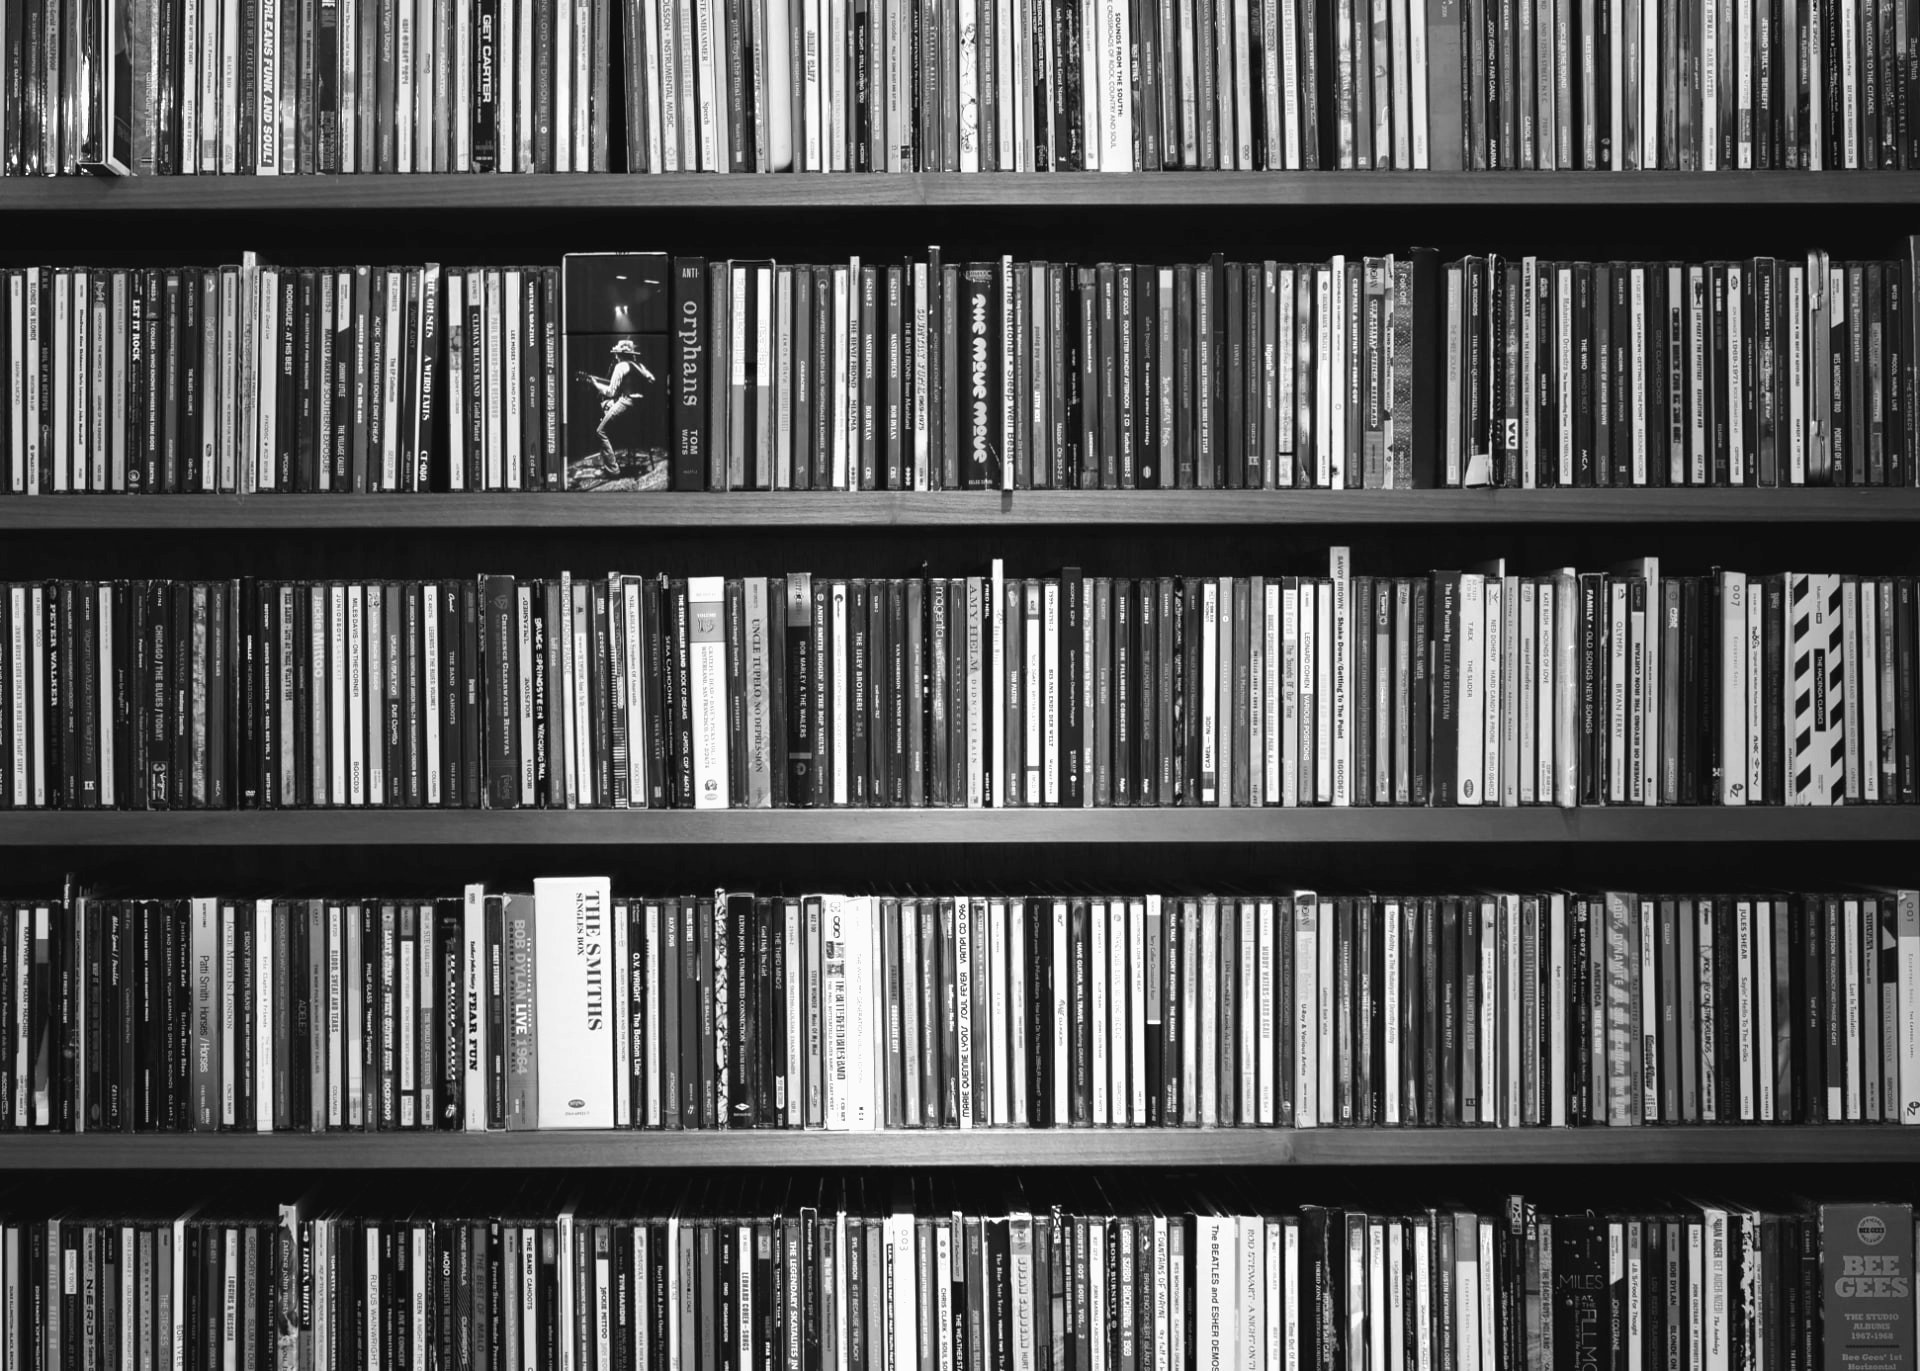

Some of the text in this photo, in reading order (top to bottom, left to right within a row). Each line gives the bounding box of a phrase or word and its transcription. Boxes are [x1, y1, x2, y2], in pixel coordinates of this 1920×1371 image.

[731, 19, 740, 38] pink
[483, 14, 492, 102] GET CARTER
[732, 39, 740, 60] floyd
[1108, 49, 1114, 59] OF
[264, 58, 273, 93] FUNK
[264, 95, 272, 123] AND
[666, 101, 674, 128] MUSIC
[702, 102, 710, 125] Speech
[263, 125, 272, 163] SOUL!
[132, 320, 140, 331] IT
[286, 332, 292, 342] AT
[1006, 307, 1014, 356] National
[132, 333, 140, 361] ROCK
[678, 301, 701, 407] orphans
[1005, 369, 1014, 401] Sleep
[1006, 405, 1015, 429] Well
[690, 430, 698, 454] TOM
[1006, 432, 1015, 464] Beast
[1731, 585, 1740, 606] 007
[933, 587, 944, 640] magenta
[534, 618, 543, 650] BRUCE
[752, 619, 761, 653] UNCLE
[969, 584, 978, 671] AMY HELM
[155, 625, 163, 740] CHICAGO THE BLUES TODAY!
[753, 655, 761, 698] TUPELO
[754, 701, 761, 715] NO
[1338, 694, 1344, 703] To
[1739, 909, 1747, 931] JULES
[1906, 902, 1914, 922] 001
[200, 955, 210, 974] Patti
[586, 891, 602, 1031] THE SMITHS
[200, 976, 210, 1002] Smith
[514, 920, 528, 1075] BOB DYLAN LIVE 1964
[469, 992, 477, 1071] FEAR FUN
[1742, 1018, 1748, 1027] To
[1211, 1225, 1219, 1241] The
[477, 1252, 485, 1273] THE
[1211, 1243, 1219, 1285] BEATLES
[1843, 1255, 1900, 1276] BEE
[476, 1275, 484, 1299] BEST
[1559, 1274, 1604, 1290] MILES
[1834, 1277, 1909, 1298] GEES
[1211, 1287, 1219, 1304] and
[476, 1303, 485, 1315] OF
[1844, 1313, 1899, 1321] THE STUDIO
[1211, 1306, 1219, 1337] ESHER
[1851, 1332, 1894, 1340] 1967-1968
[1670, 1358, 1677, 1370] ON
